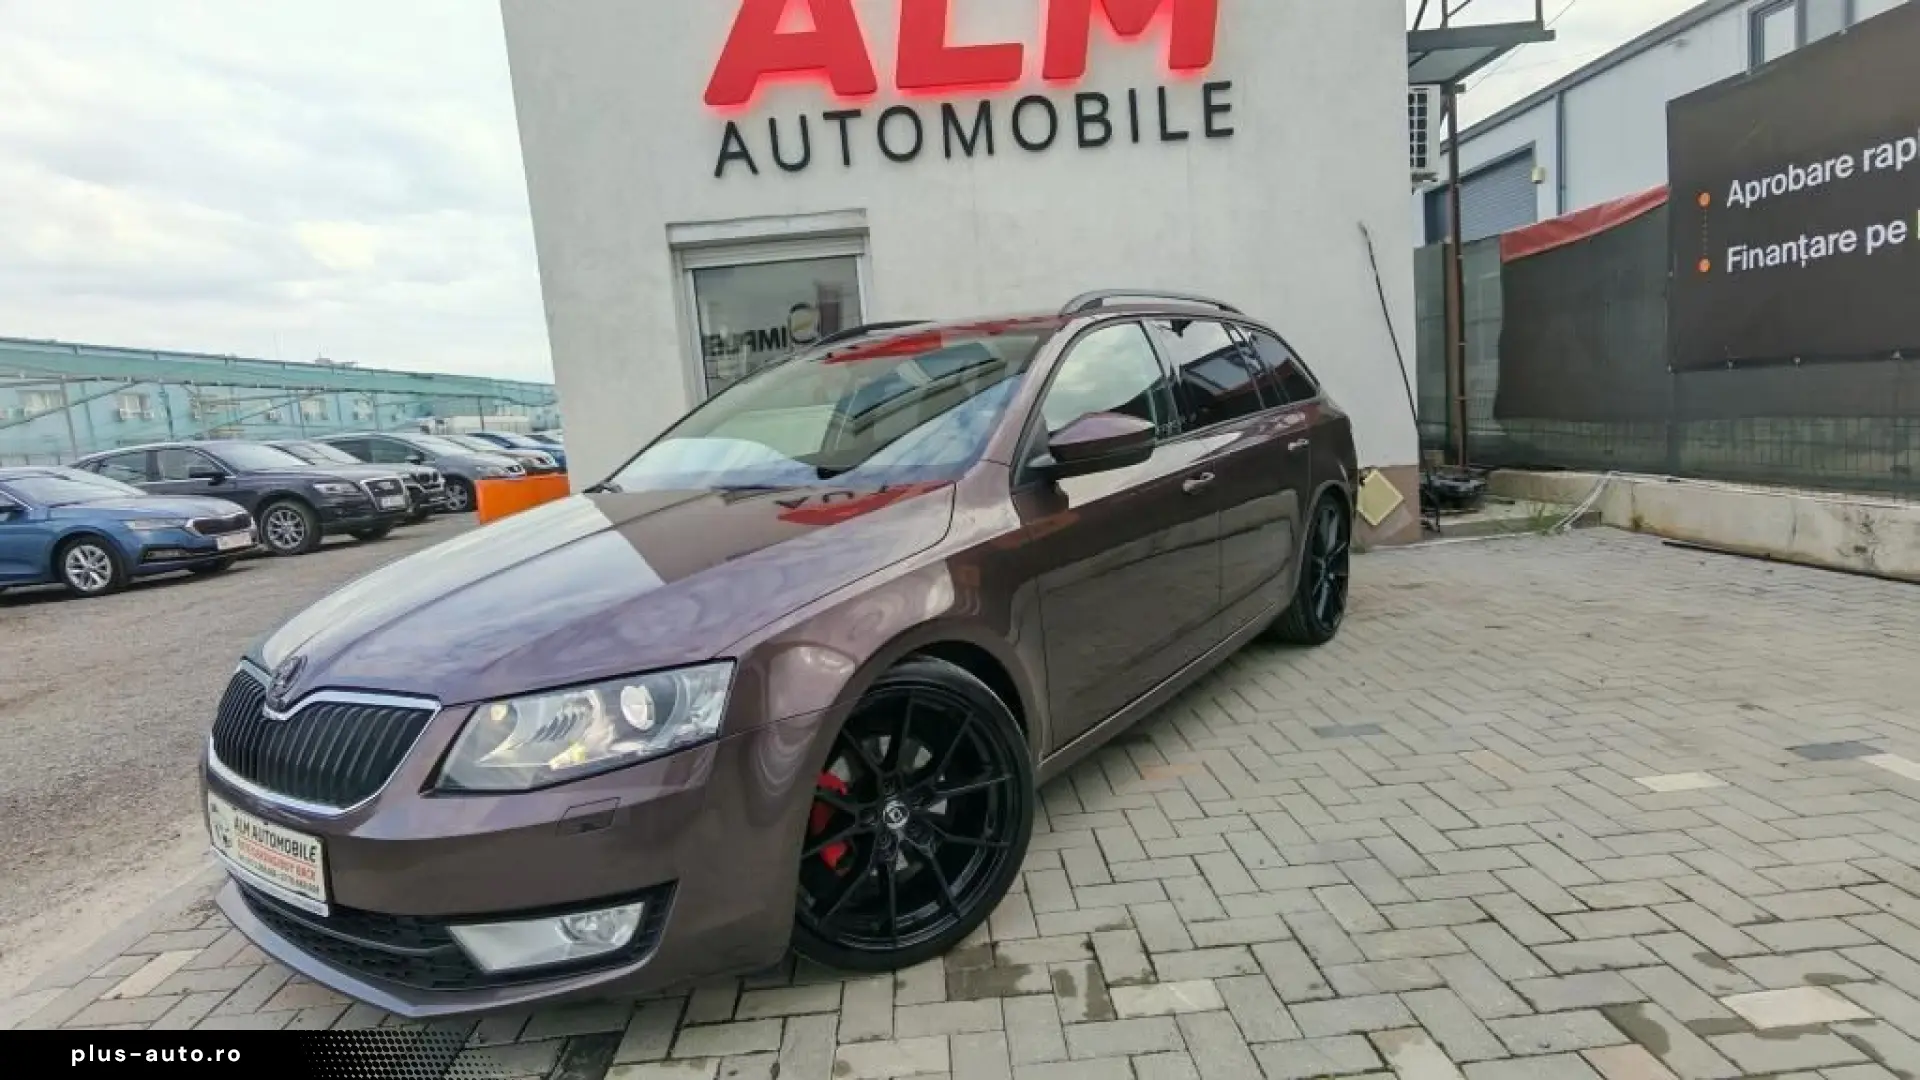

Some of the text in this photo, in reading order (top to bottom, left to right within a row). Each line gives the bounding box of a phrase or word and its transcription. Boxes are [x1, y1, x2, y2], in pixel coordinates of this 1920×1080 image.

[704, 0, 1217, 105] ALM
[714, 81, 1235, 178] AUTOMOBILE
[1726, 154, 1855, 208] Aprobare
[1726, 228, 1858, 273] Finanțare
[1866, 219, 1908, 255] pe
[252, 824, 318, 863] AUTOMOBILE
